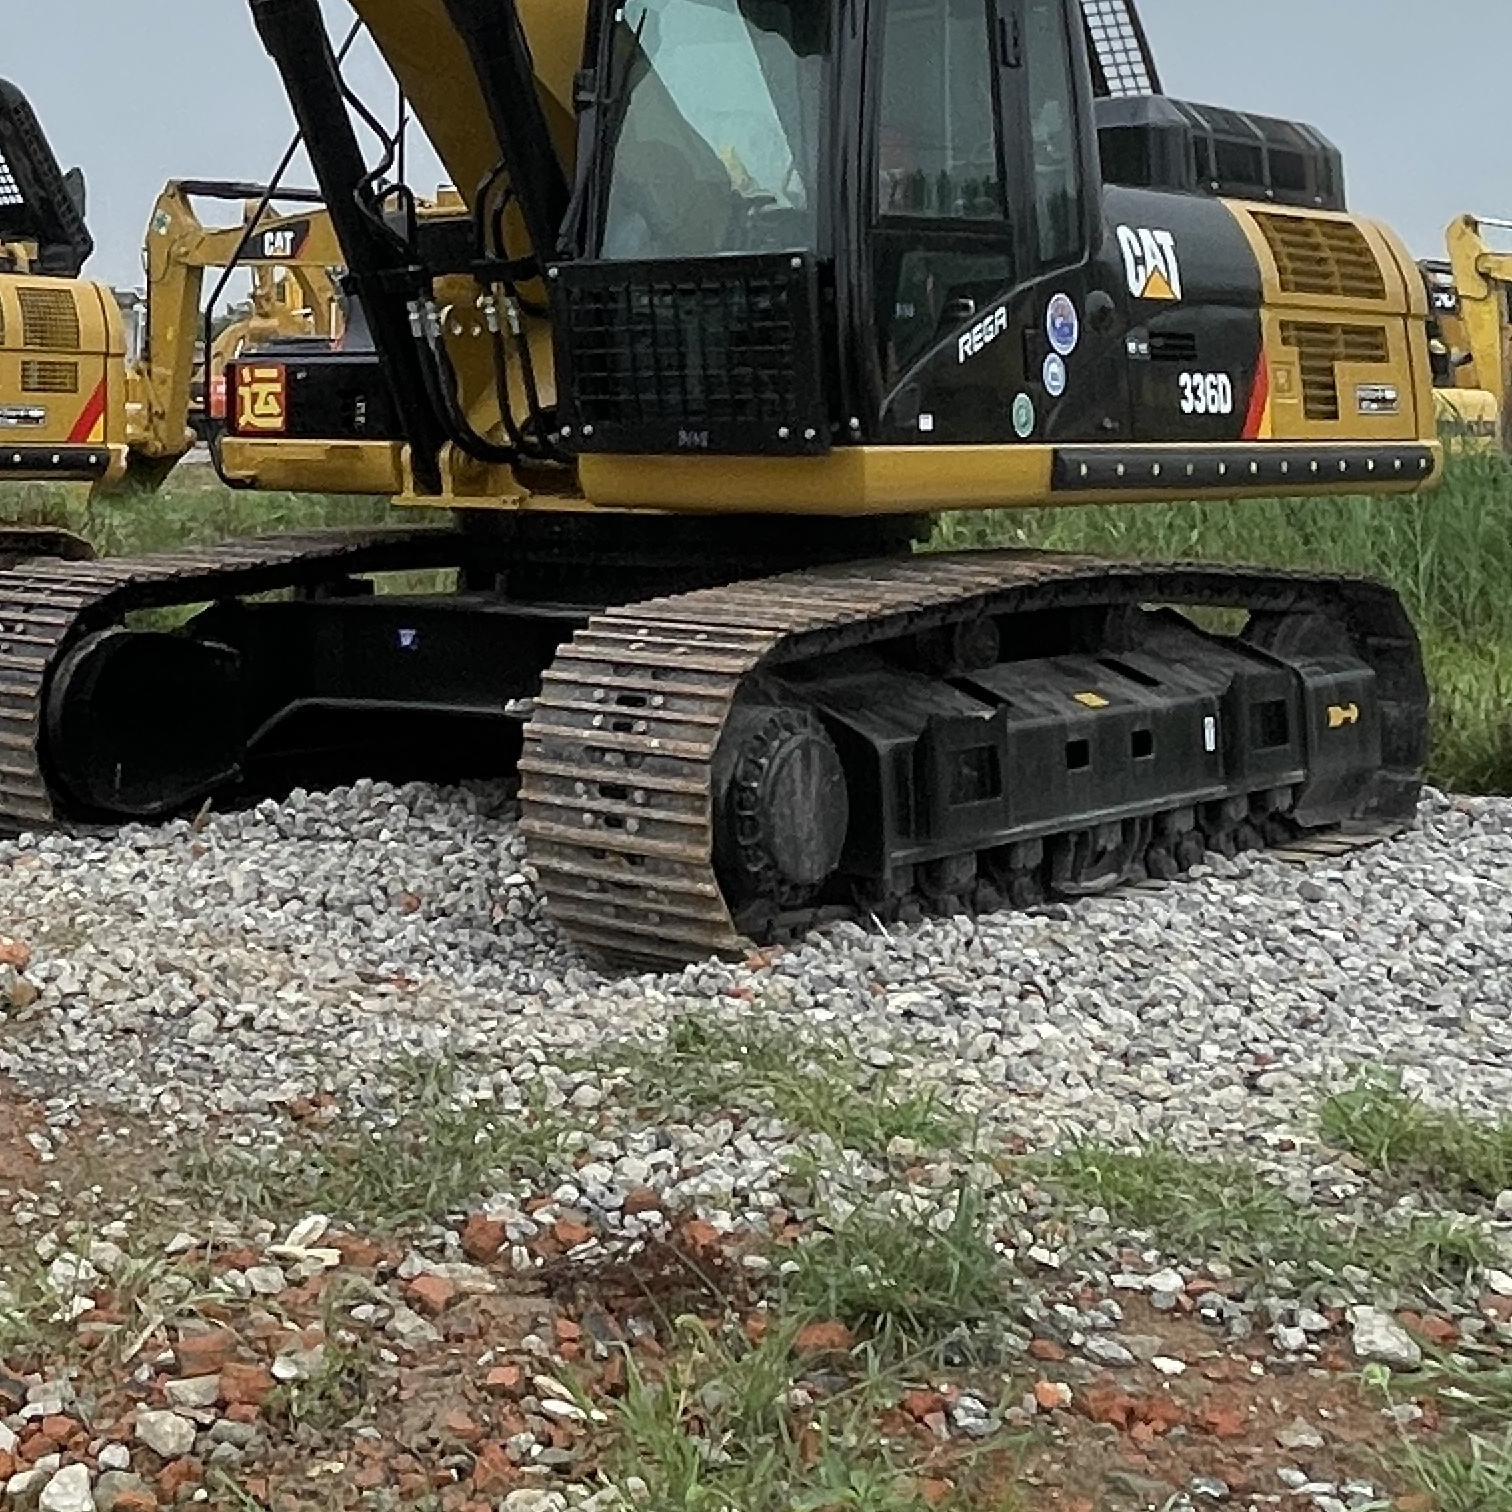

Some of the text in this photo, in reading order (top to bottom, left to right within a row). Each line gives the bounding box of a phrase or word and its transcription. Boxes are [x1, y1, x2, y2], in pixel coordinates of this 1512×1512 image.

[264, 230, 295, 256] CAT
[1116, 224, 1182, 301] CAT
[238, 366, 286, 431] 运
[1178, 372, 1233, 414] 336D
